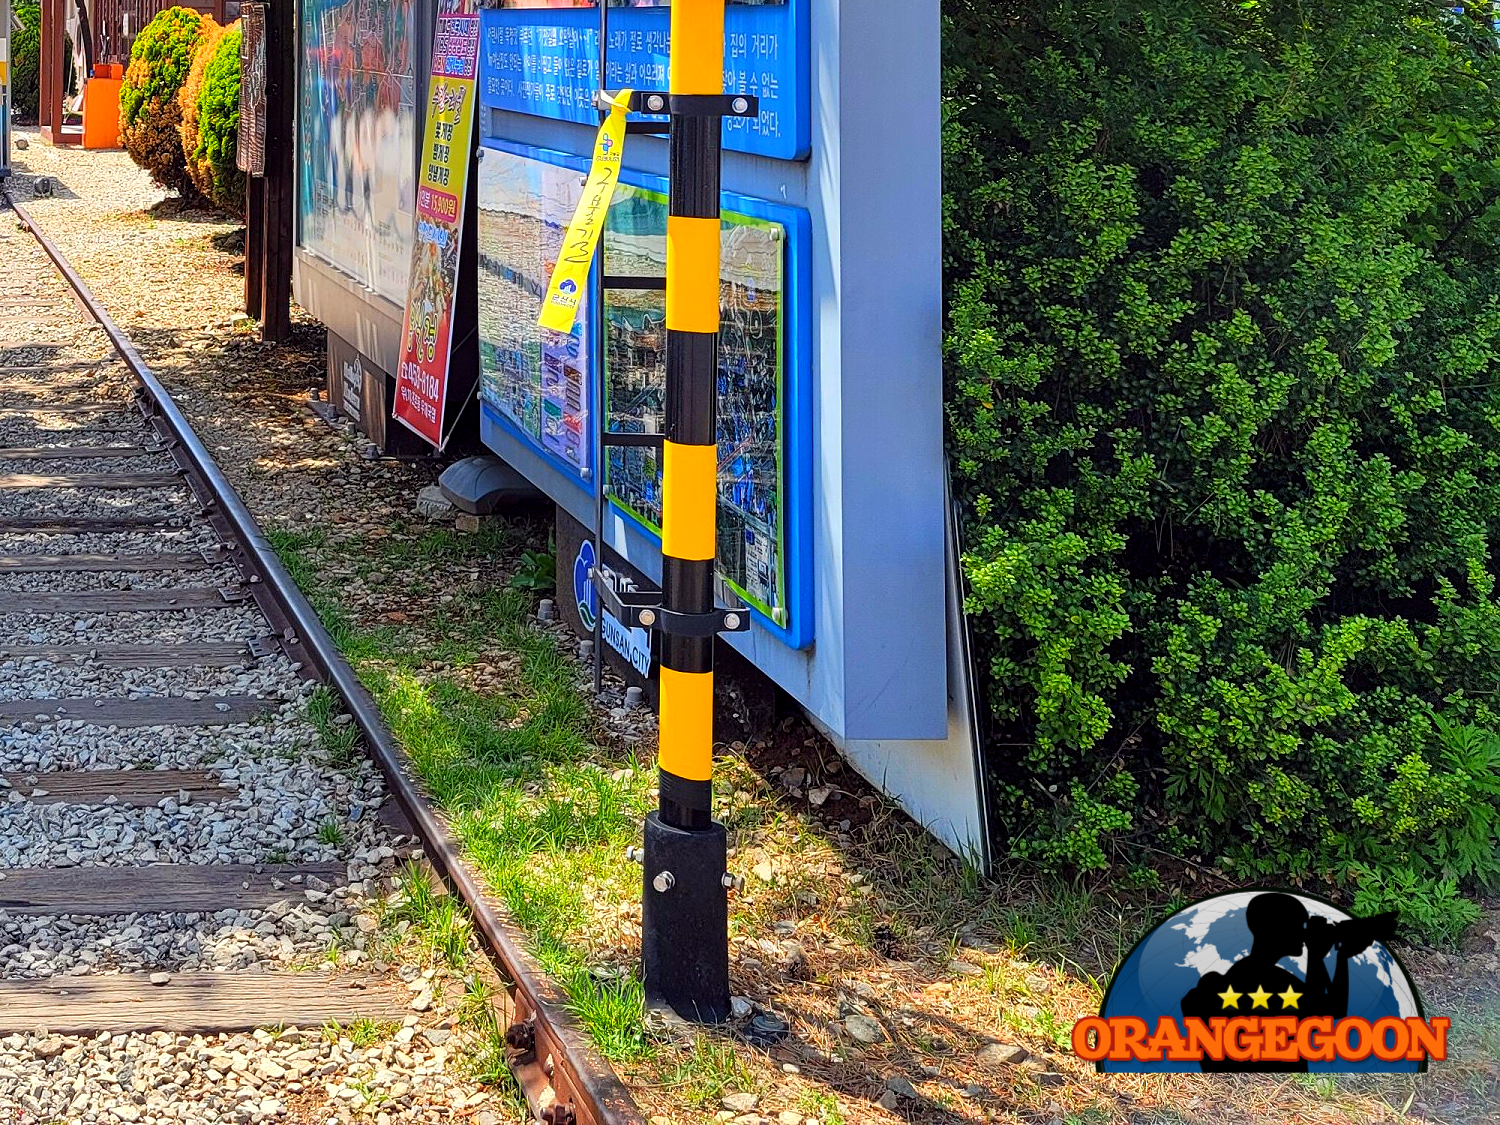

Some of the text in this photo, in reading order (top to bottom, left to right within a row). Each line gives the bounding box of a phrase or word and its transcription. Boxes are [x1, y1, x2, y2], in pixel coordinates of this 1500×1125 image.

[609, 31, 627, 52] 노래가
[630, 31, 643, 53] 절로
[730, 33, 747, 58] 집의
[751, 34, 778, 60] 거리가
[761, 73, 779, 99] 없는
[602, 618, 650, 673] GUNSAN CITY
